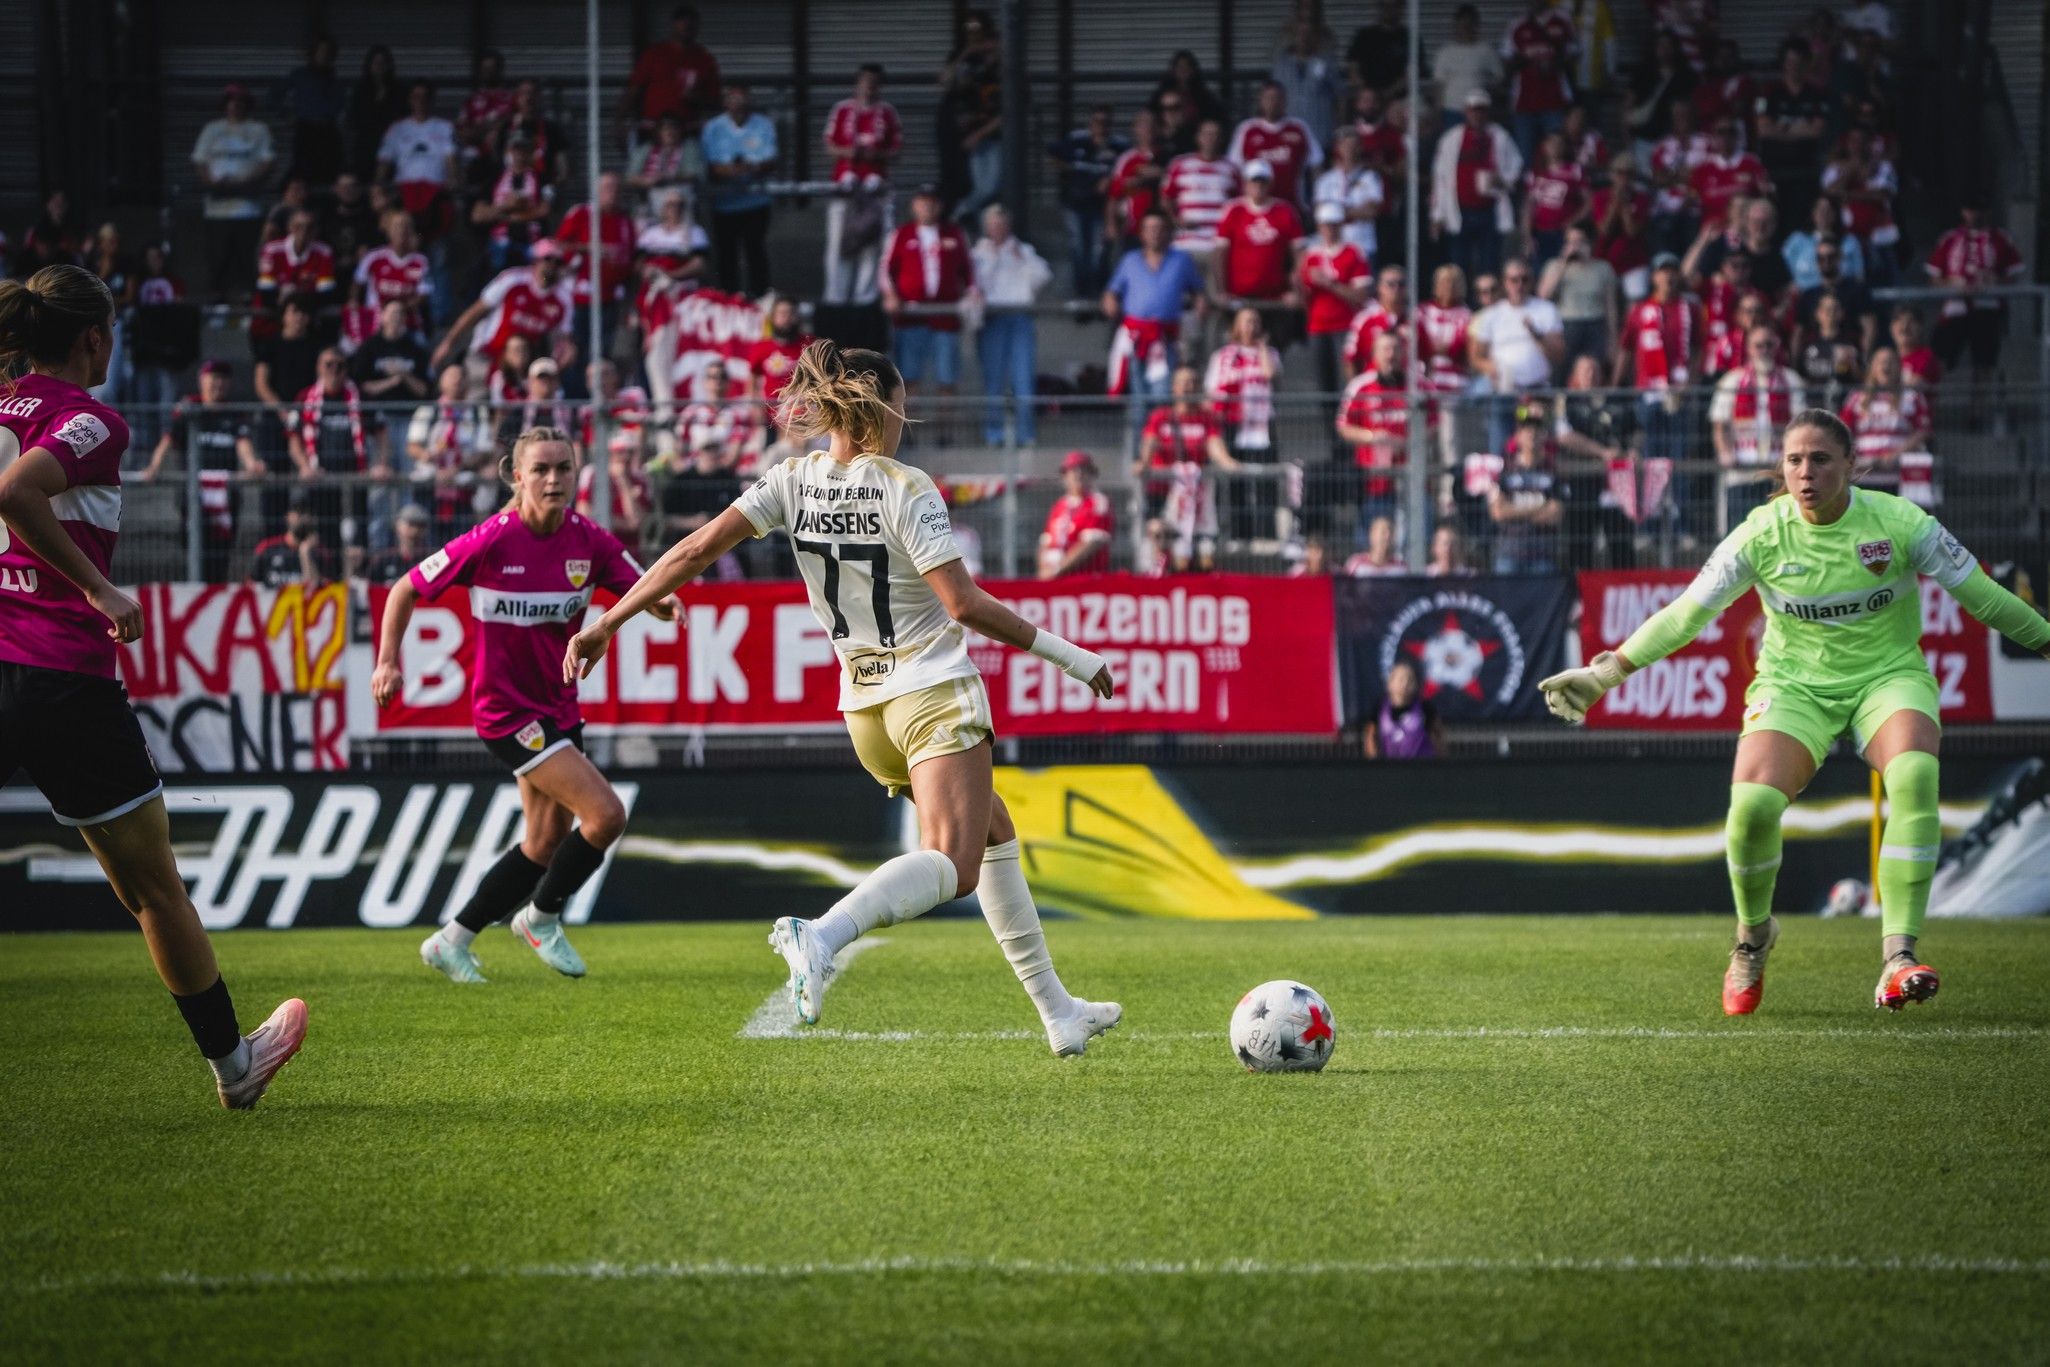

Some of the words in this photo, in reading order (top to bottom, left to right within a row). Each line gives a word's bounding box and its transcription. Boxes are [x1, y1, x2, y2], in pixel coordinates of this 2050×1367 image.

[845, 486, 884, 501] BERLIN
[794, 537, 897, 649] 77
[494, 599, 560, 618] Allianz
[1784, 601, 1862, 620] Allianz
[402, 604, 749, 708] BCK
[857, 661, 889, 678] bella
